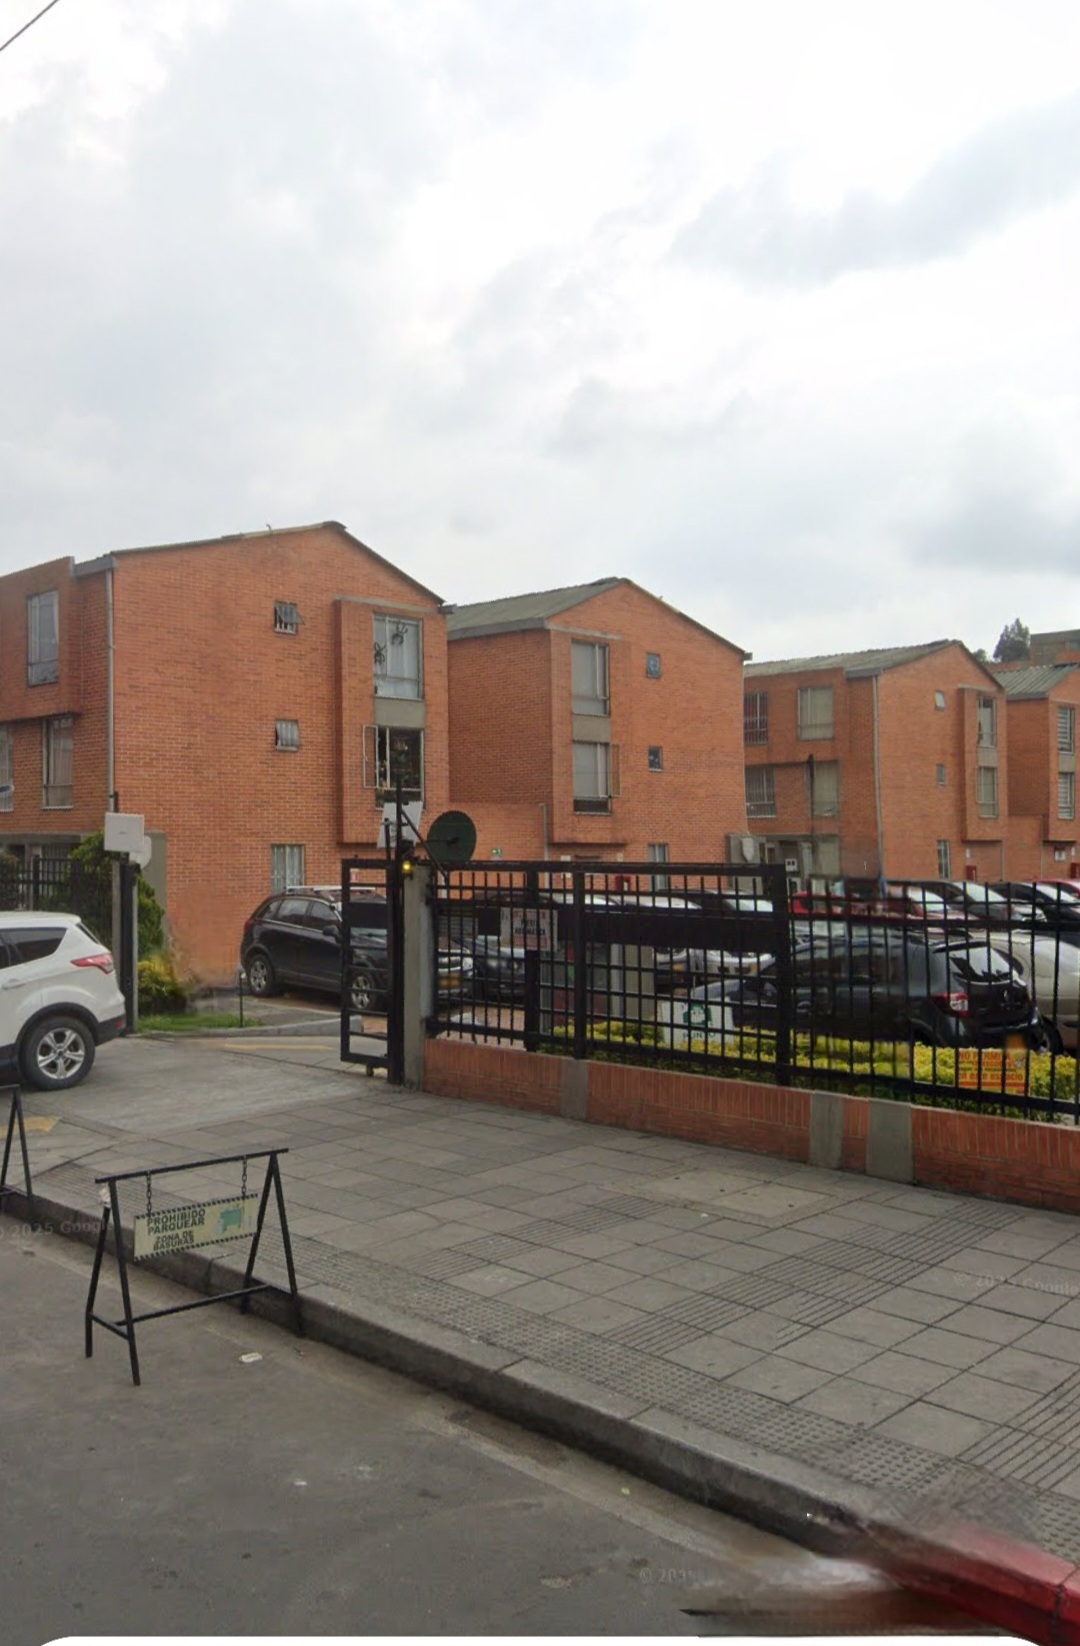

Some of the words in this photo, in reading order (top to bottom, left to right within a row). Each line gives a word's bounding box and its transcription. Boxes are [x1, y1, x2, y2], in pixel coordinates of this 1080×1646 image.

[147, 1208, 206, 1227] PROHIBIDO
[147, 1216, 206, 1236] PARQUEAR
[153, 1235, 195, 1251] BASURAS
[155, 1232, 180, 1244] ZONA
[182, 1229, 194, 1239] DE
